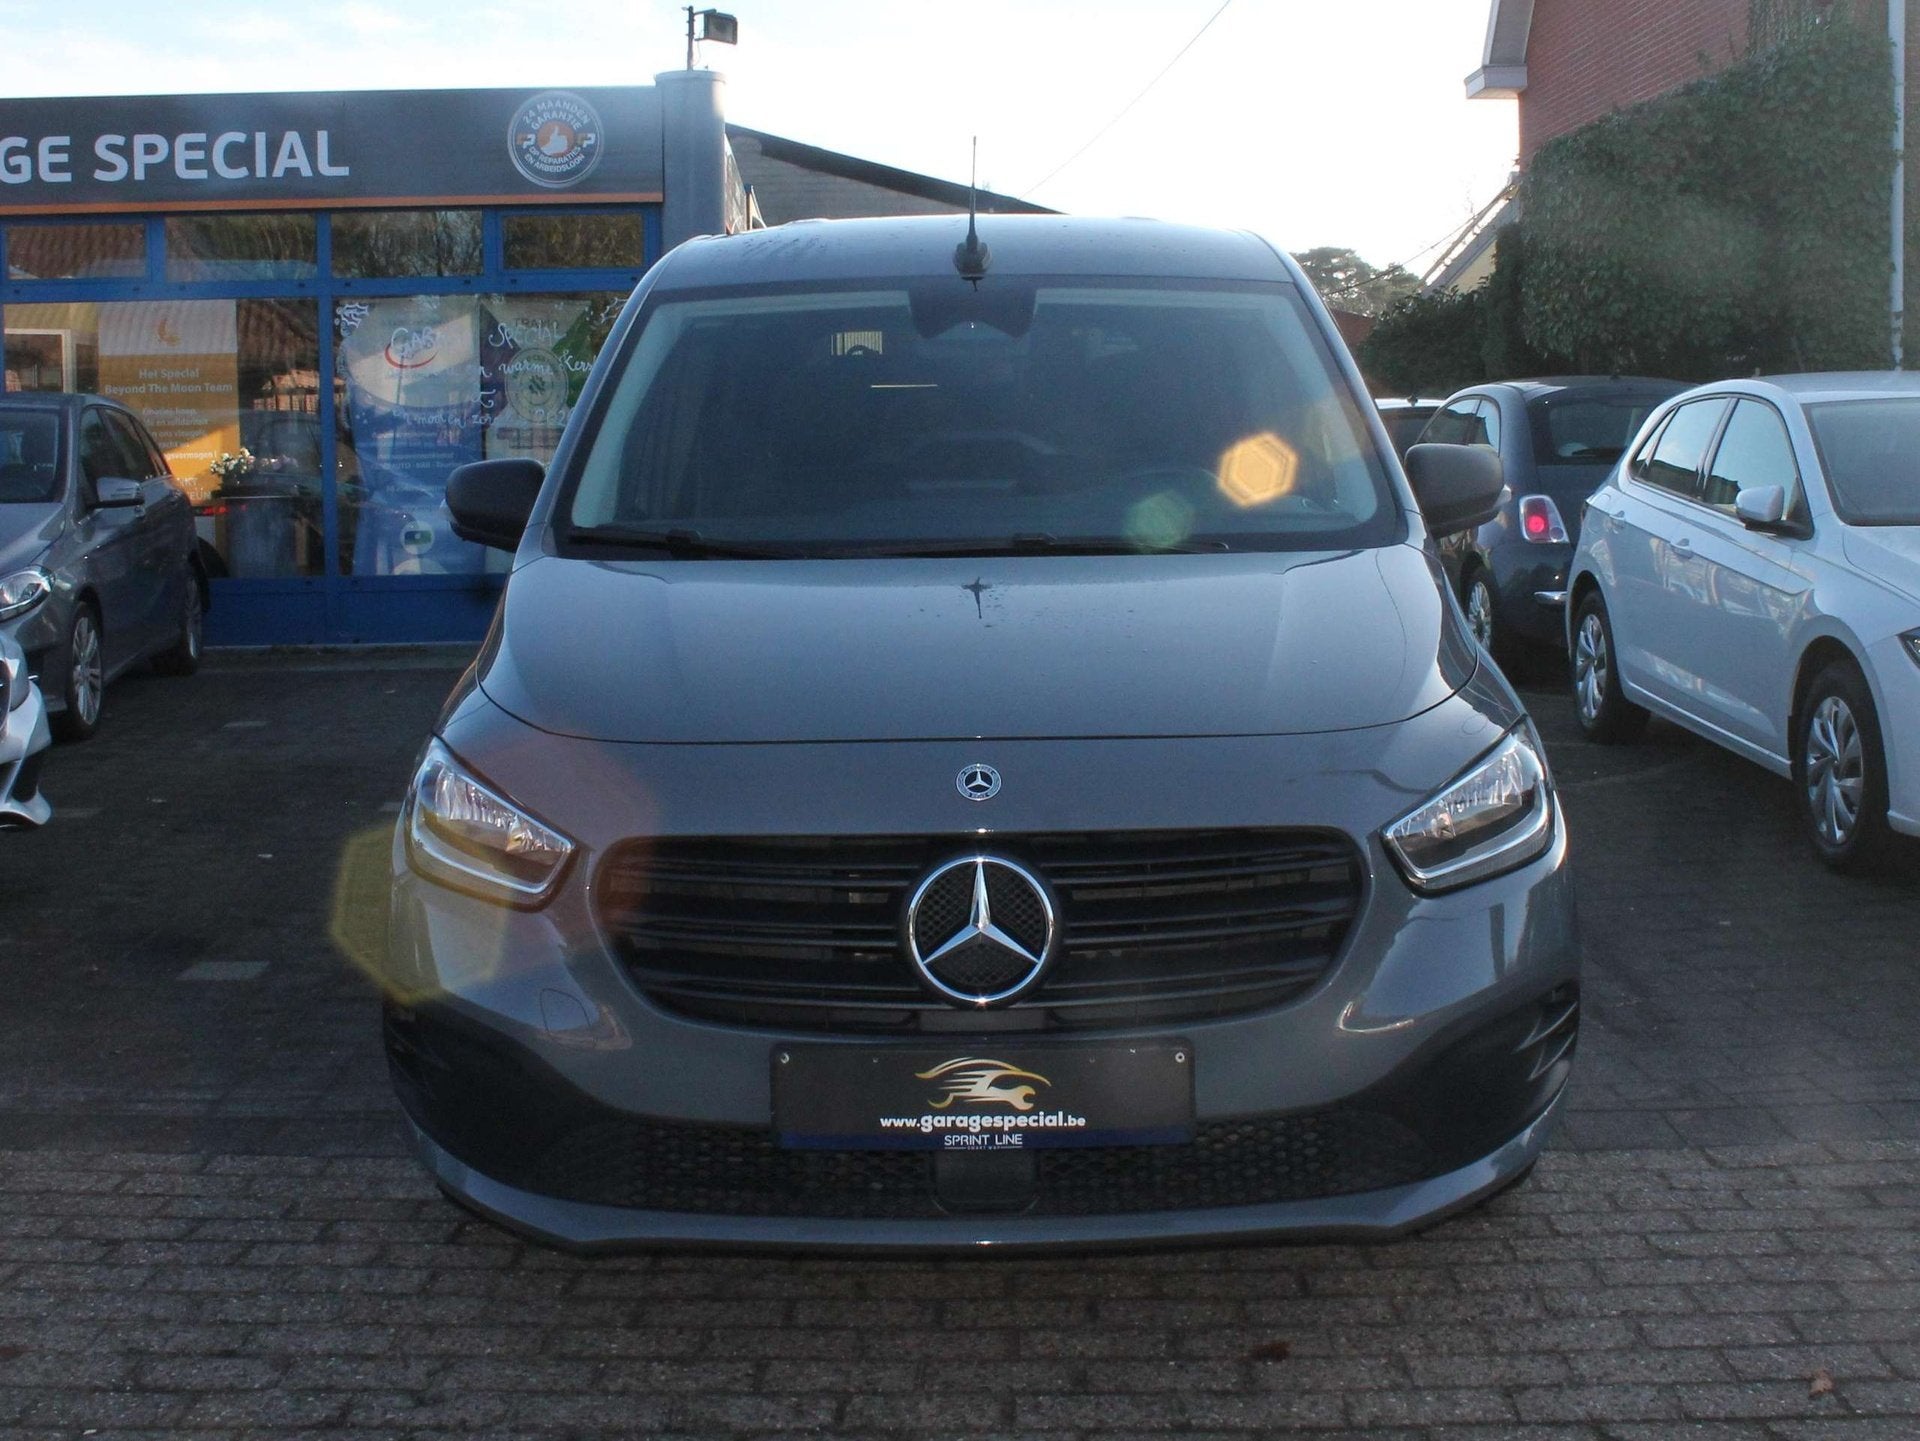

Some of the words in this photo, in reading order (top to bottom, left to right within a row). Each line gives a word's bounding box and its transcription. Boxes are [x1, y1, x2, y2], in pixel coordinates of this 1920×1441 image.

[531, 111, 583, 130] GARANTIE
[536, 99, 590, 125] MAANDEN
[93, 130, 349, 181] SPECIAL
[533, 153, 586, 173] ARBEIDSLOON
[160, 368, 200, 380] Special
[104, 384, 146, 396] Beyond
[148, 384, 168, 394] The
[170, 383, 202, 394] Moon
[204, 382, 233, 393] Team
[880, 1111, 1086, 1133] www.garagespecial.be
[944, 1134, 990, 1146] SPRINT
[995, 1133, 1024, 1145] LINE
